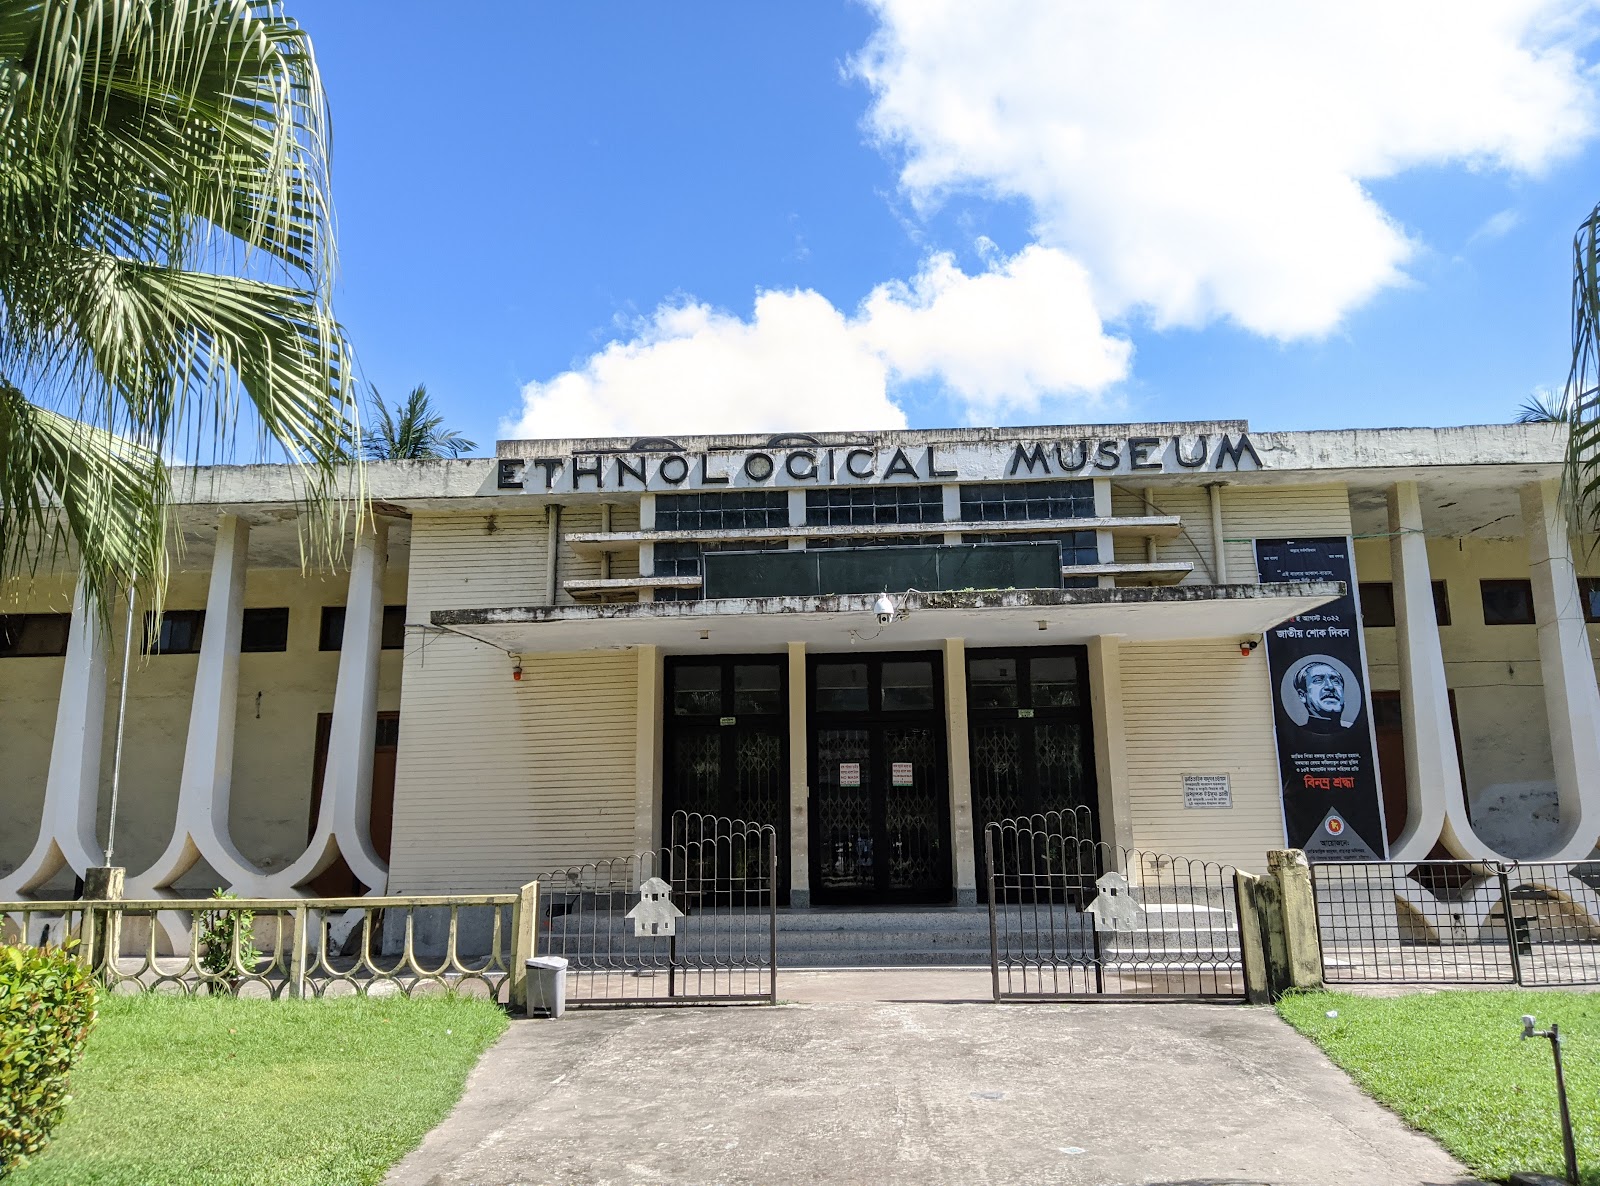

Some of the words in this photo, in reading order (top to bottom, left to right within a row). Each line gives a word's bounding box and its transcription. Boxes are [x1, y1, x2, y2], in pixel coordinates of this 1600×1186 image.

[498, 447, 958, 489] ETHNOLOGICAL
[1010, 433, 1263, 475] MUSEUM
[1301, 614, 1321, 622] আগস্ট
[1276, 627, 1304, 639] জাতীয়
[1306, 629, 1327, 638] শোক
[1328, 626, 1350, 638] দিবস
[1303, 774, 1330, 790] বিনম্র
[1332, 777, 1355, 788] শ্রদ্ধা
